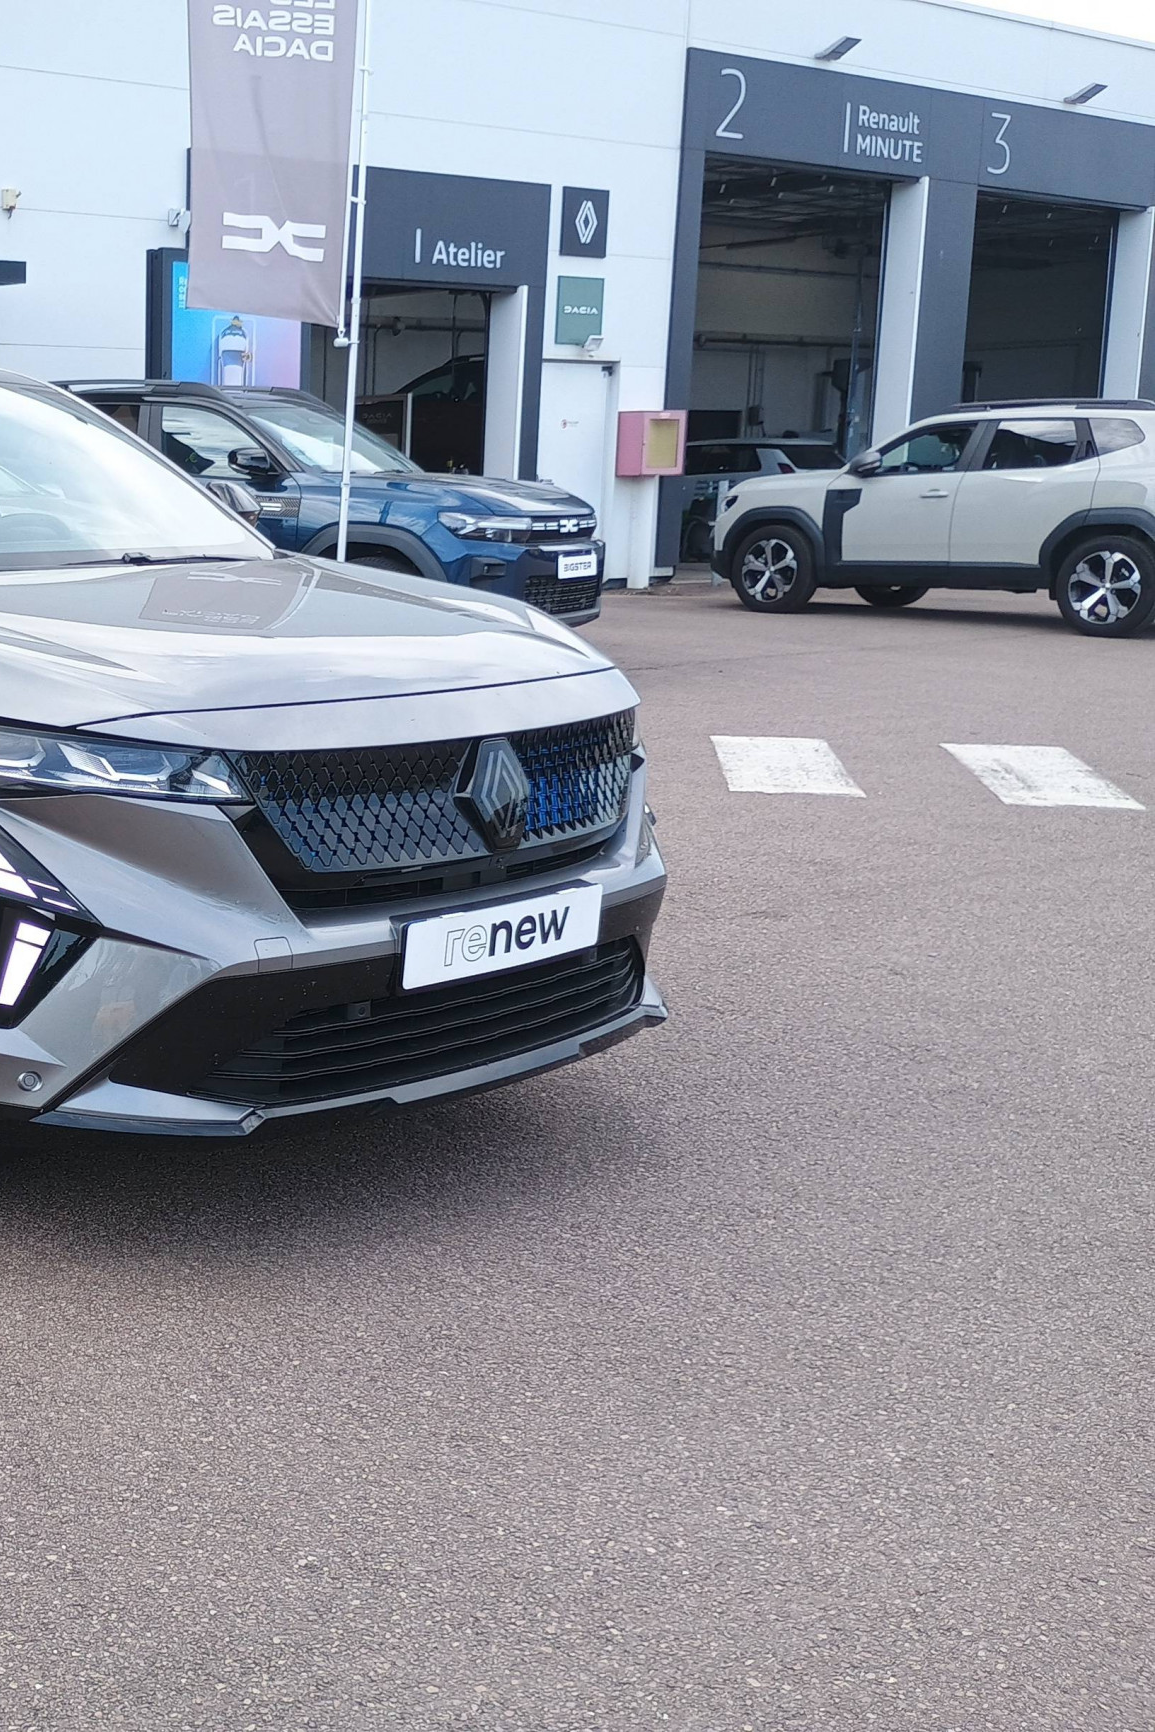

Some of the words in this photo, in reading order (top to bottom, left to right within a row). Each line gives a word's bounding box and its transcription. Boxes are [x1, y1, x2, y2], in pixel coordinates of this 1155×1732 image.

[715, 67, 747, 140] 2
[857, 104, 921, 136] Renault
[855, 133, 923, 163] MINUTE
[985, 111, 1013, 175] 3
[431, 240, 506, 269] Atelier
[563, 305, 599, 315] DACIA
[563, 561, 592, 573] BIGSTER
[443, 906, 571, 967] renew
